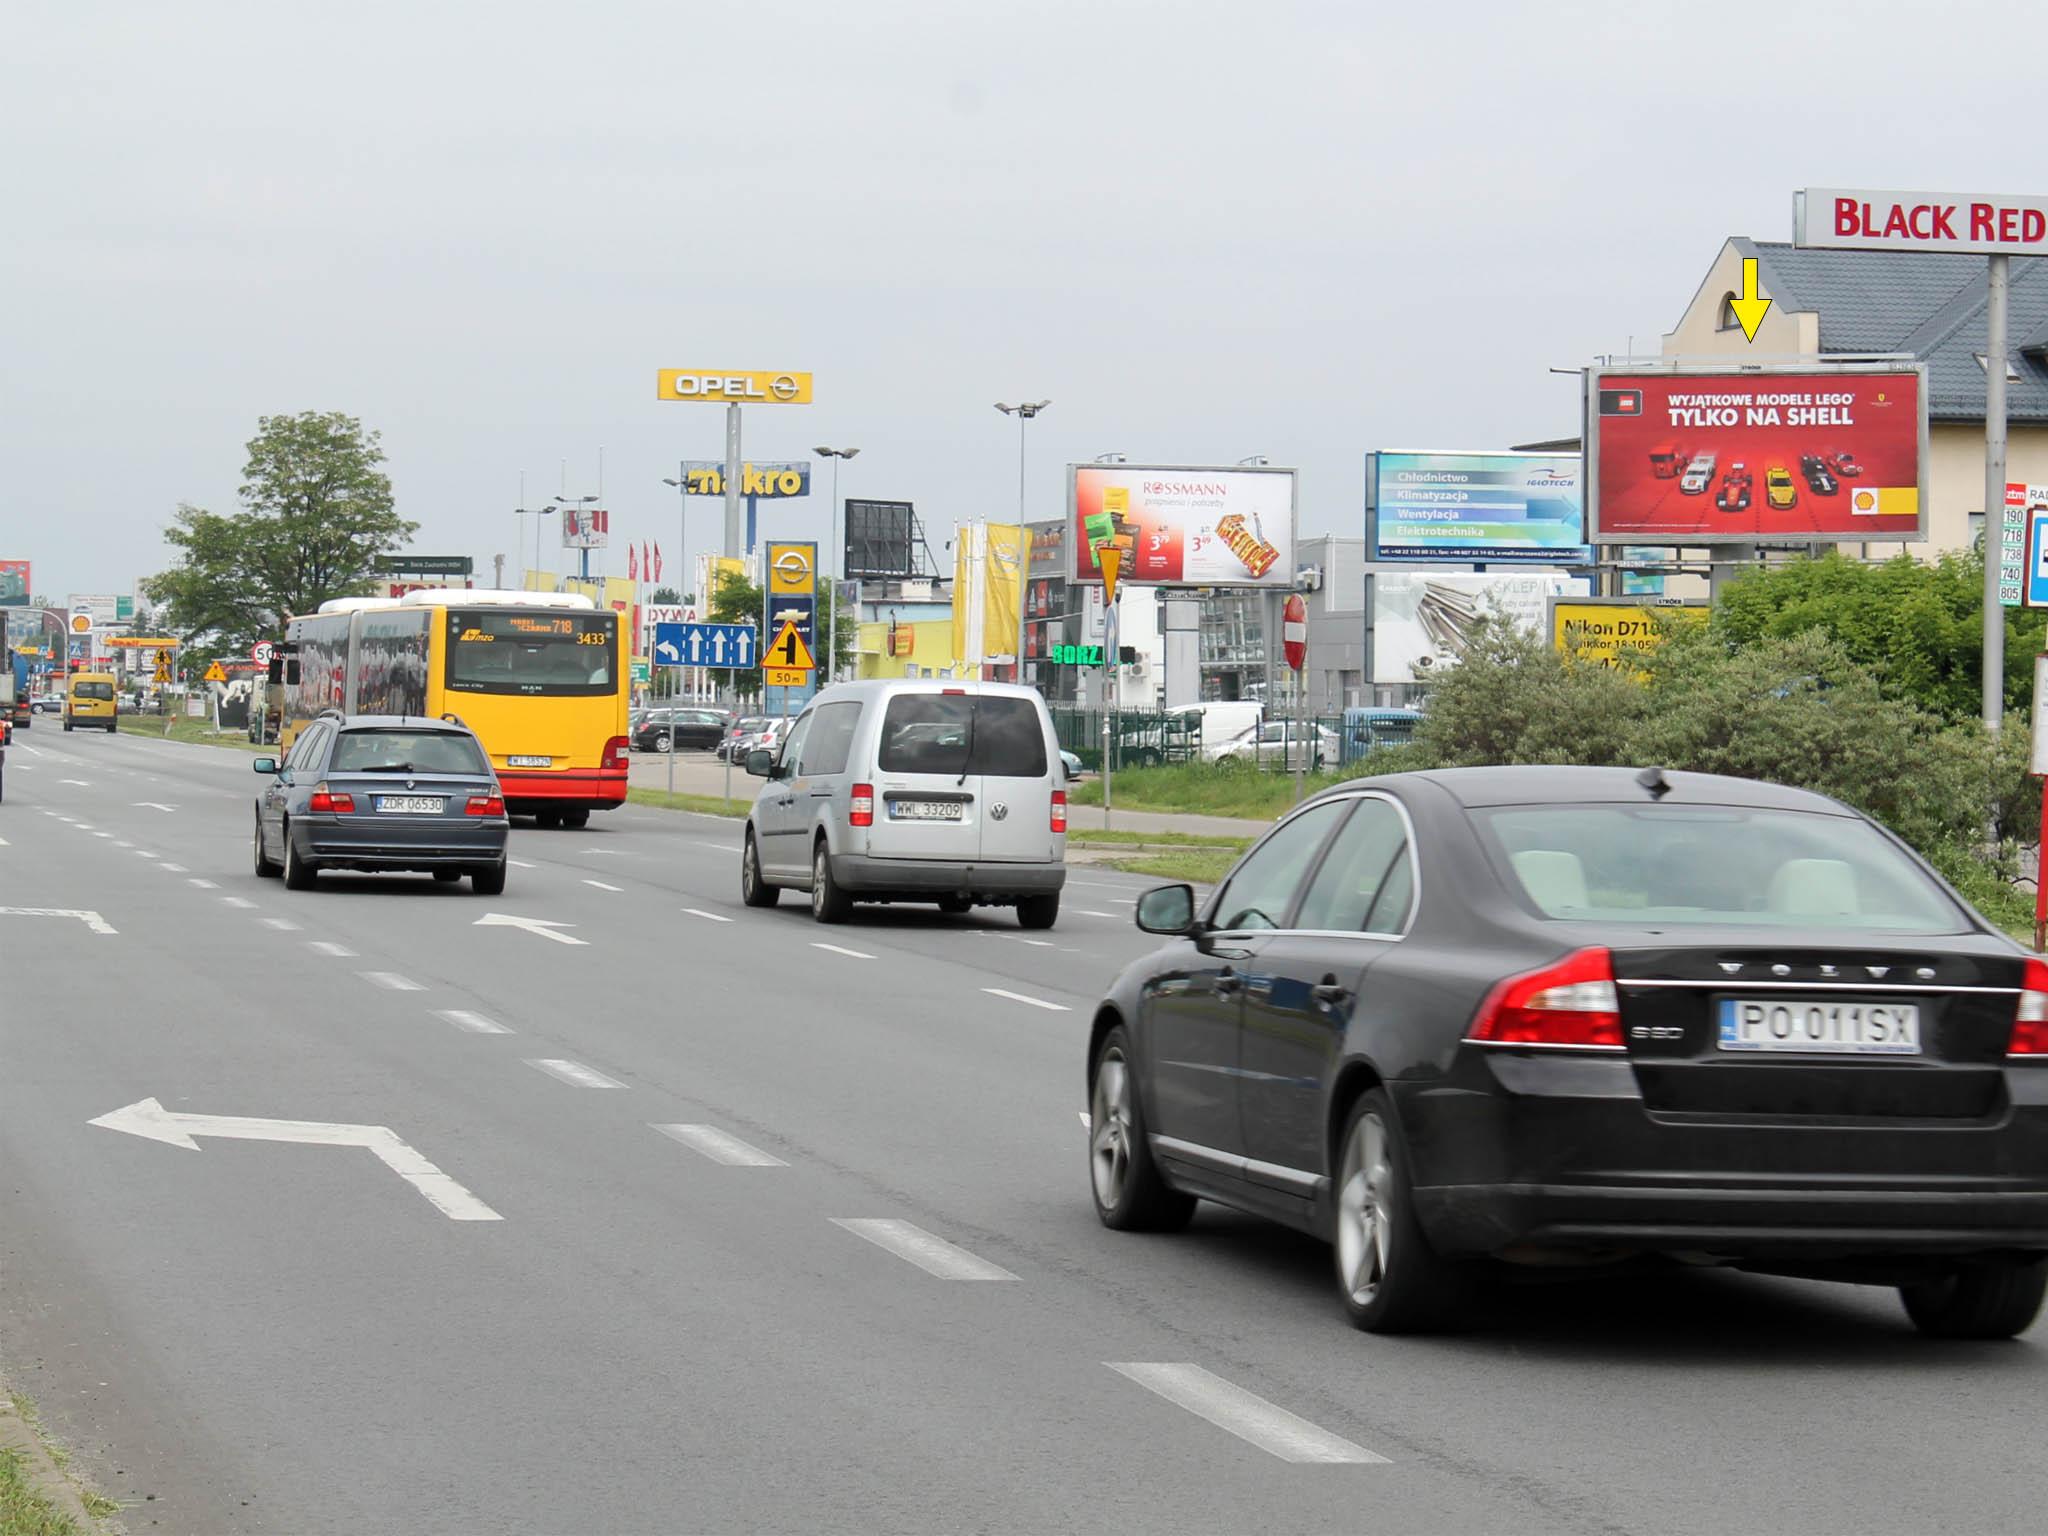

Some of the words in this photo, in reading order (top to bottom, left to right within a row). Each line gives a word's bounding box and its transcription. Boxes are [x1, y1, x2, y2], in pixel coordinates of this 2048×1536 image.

[1834, 197, 1957, 240] BLACK
[1970, 203, 2046, 243] RED
[675, 375, 766, 397] OPEL
[1668, 394, 1752, 408] WYJĄTKOWE
[1756, 394, 1813, 406] MODELE
[1668, 409, 1739, 427] TYLKO
[1746, 408, 1781, 426] NA
[1787, 408, 1853, 425] SHELL
[687, 463, 802, 496] mkro
[1397, 472, 1469, 483] Chłodnictwo
[1143, 481, 1227, 496] ROSSMANN
[1397, 489, 1469, 503] Klimatyzacja
[1398, 509, 1460, 521] Wentylacja
[2006, 510, 2023, 523] 190
[1396, 526, 1485, 538] Elektrotechnika
[2004, 529, 2022, 542] 718
[2004, 548, 2022, 561] 738
[2002, 567, 2020, 580] 740
[2000, 587, 2019, 600] 805
[552, 619, 573, 634] 718
[576, 632, 605, 645] 3433
[776, 672, 791, 683] 50
[383, 797, 405, 810] ZDR
[408, 798, 442, 811] 06530
[897, 803, 919, 816] WWL
[924, 803, 961, 817] 33209
[1742, 1004, 1792, 1040] PO
[1805, 1006, 1913, 1043] 011SX
